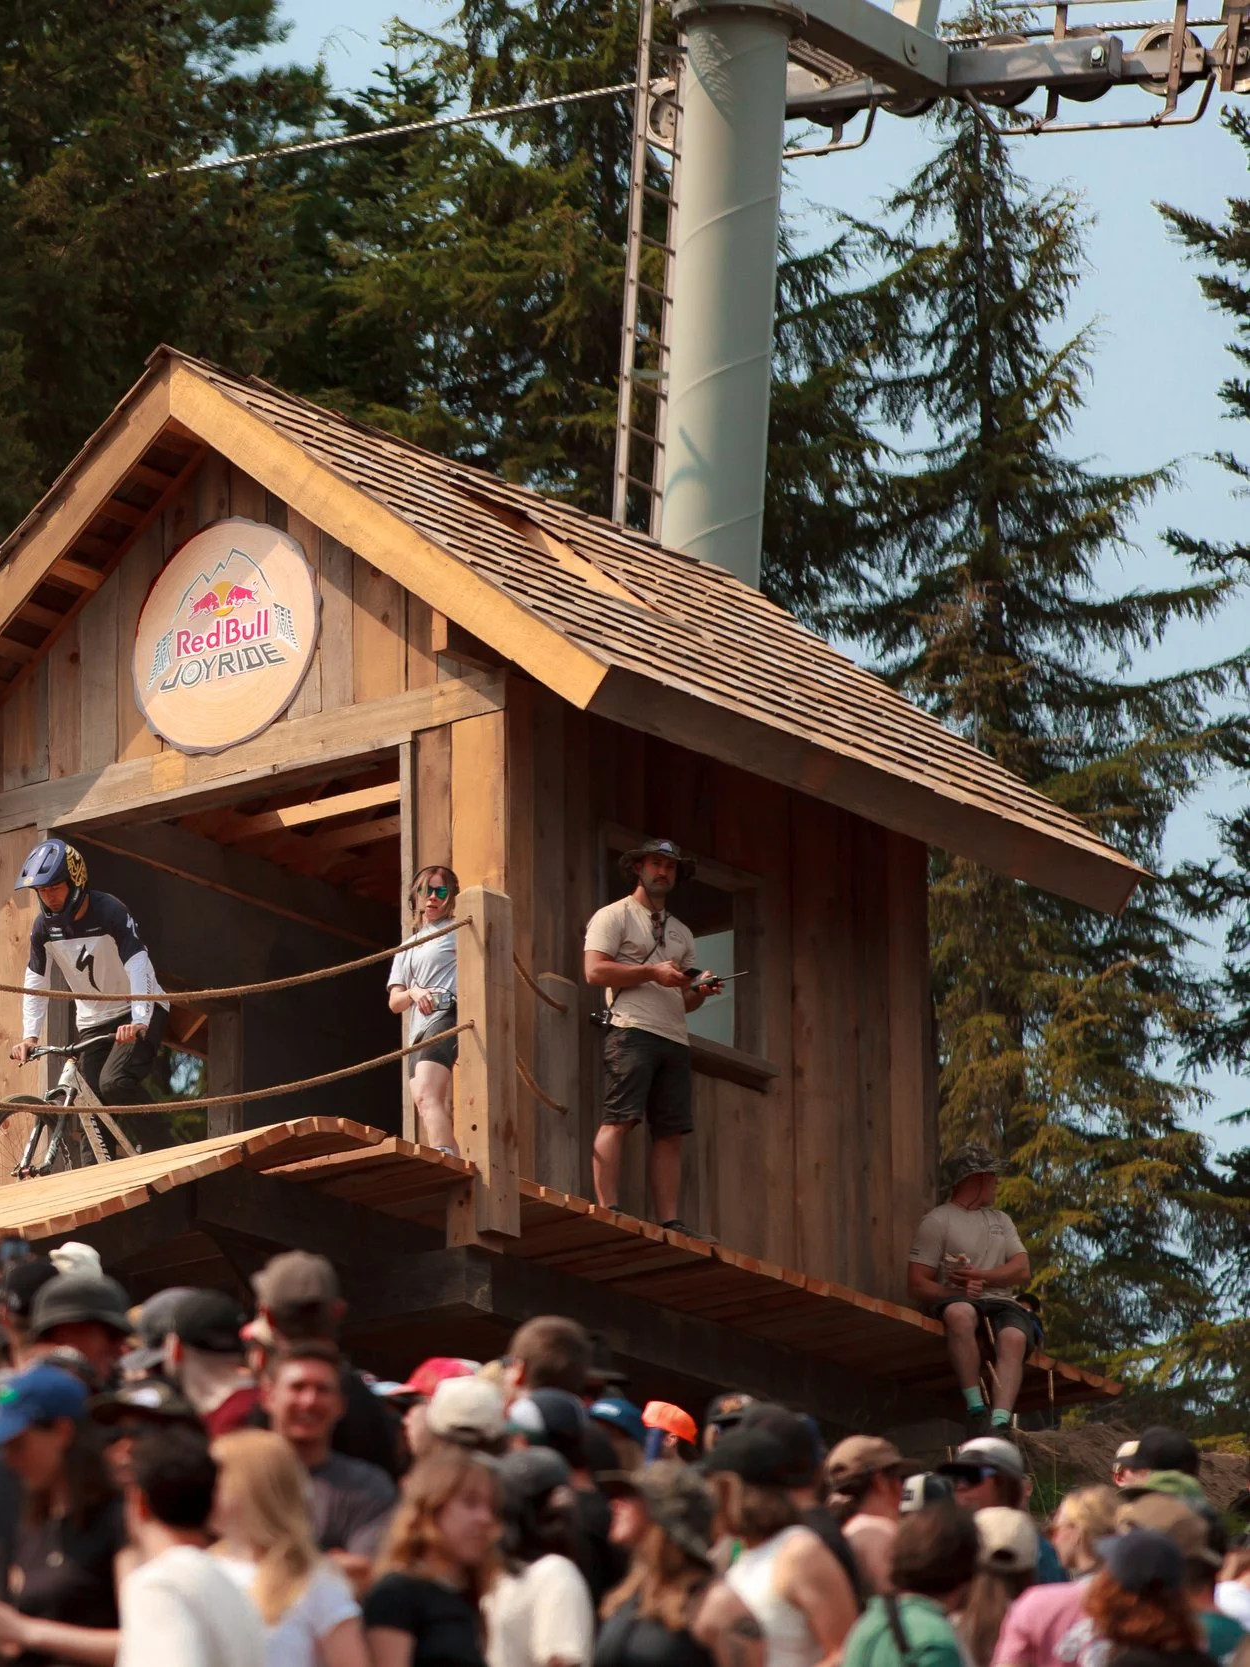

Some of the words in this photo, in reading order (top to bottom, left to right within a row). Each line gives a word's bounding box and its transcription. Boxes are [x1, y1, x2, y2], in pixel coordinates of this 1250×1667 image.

[176, 620, 220, 657] Red
[225, 609, 268, 645] Bull
[160, 642, 286, 691] JOYRIDE
